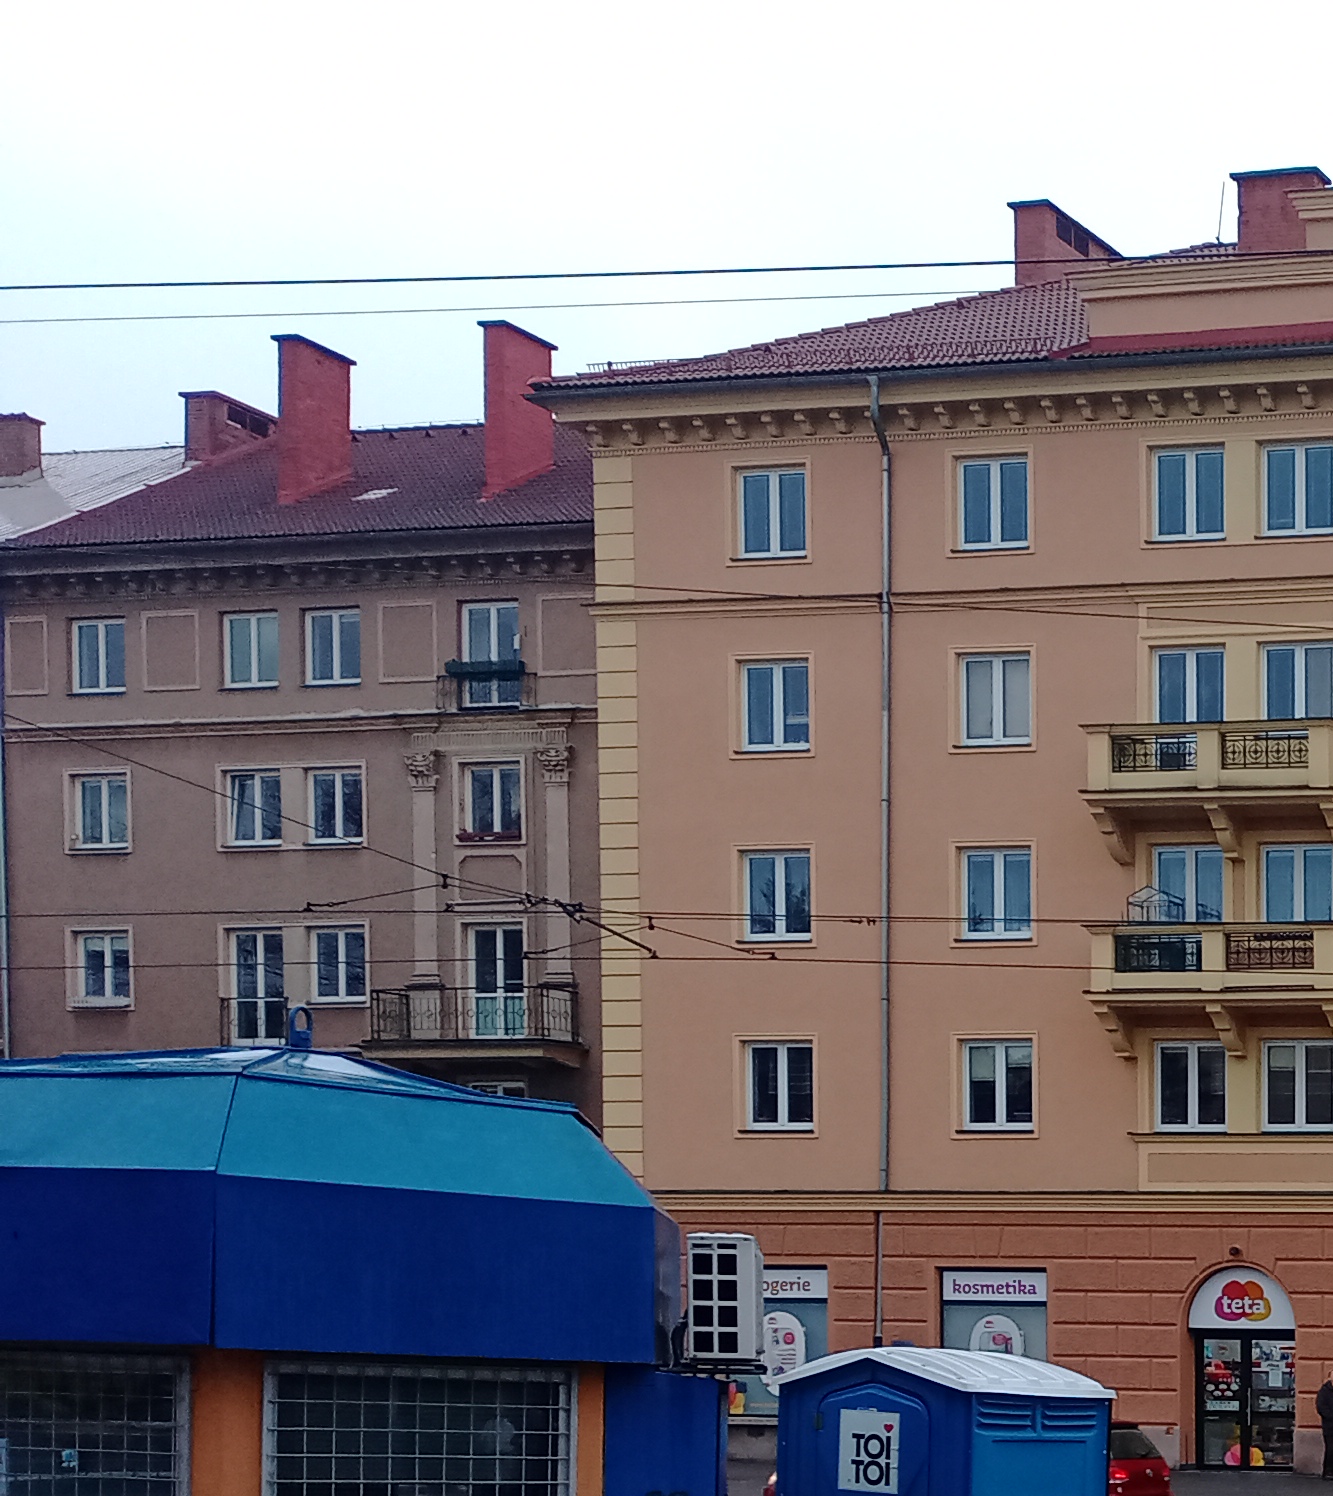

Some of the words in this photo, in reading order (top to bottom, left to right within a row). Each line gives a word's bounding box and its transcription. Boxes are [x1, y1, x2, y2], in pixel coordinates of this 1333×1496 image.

[762, 1276, 811, 1295] ogerie
[952, 1278, 1038, 1295] kosmetika
[1221, 1295, 1266, 1314] teta
[851, 1432, 891, 1460] TOI
[850, 1458, 891, 1486] TOI
